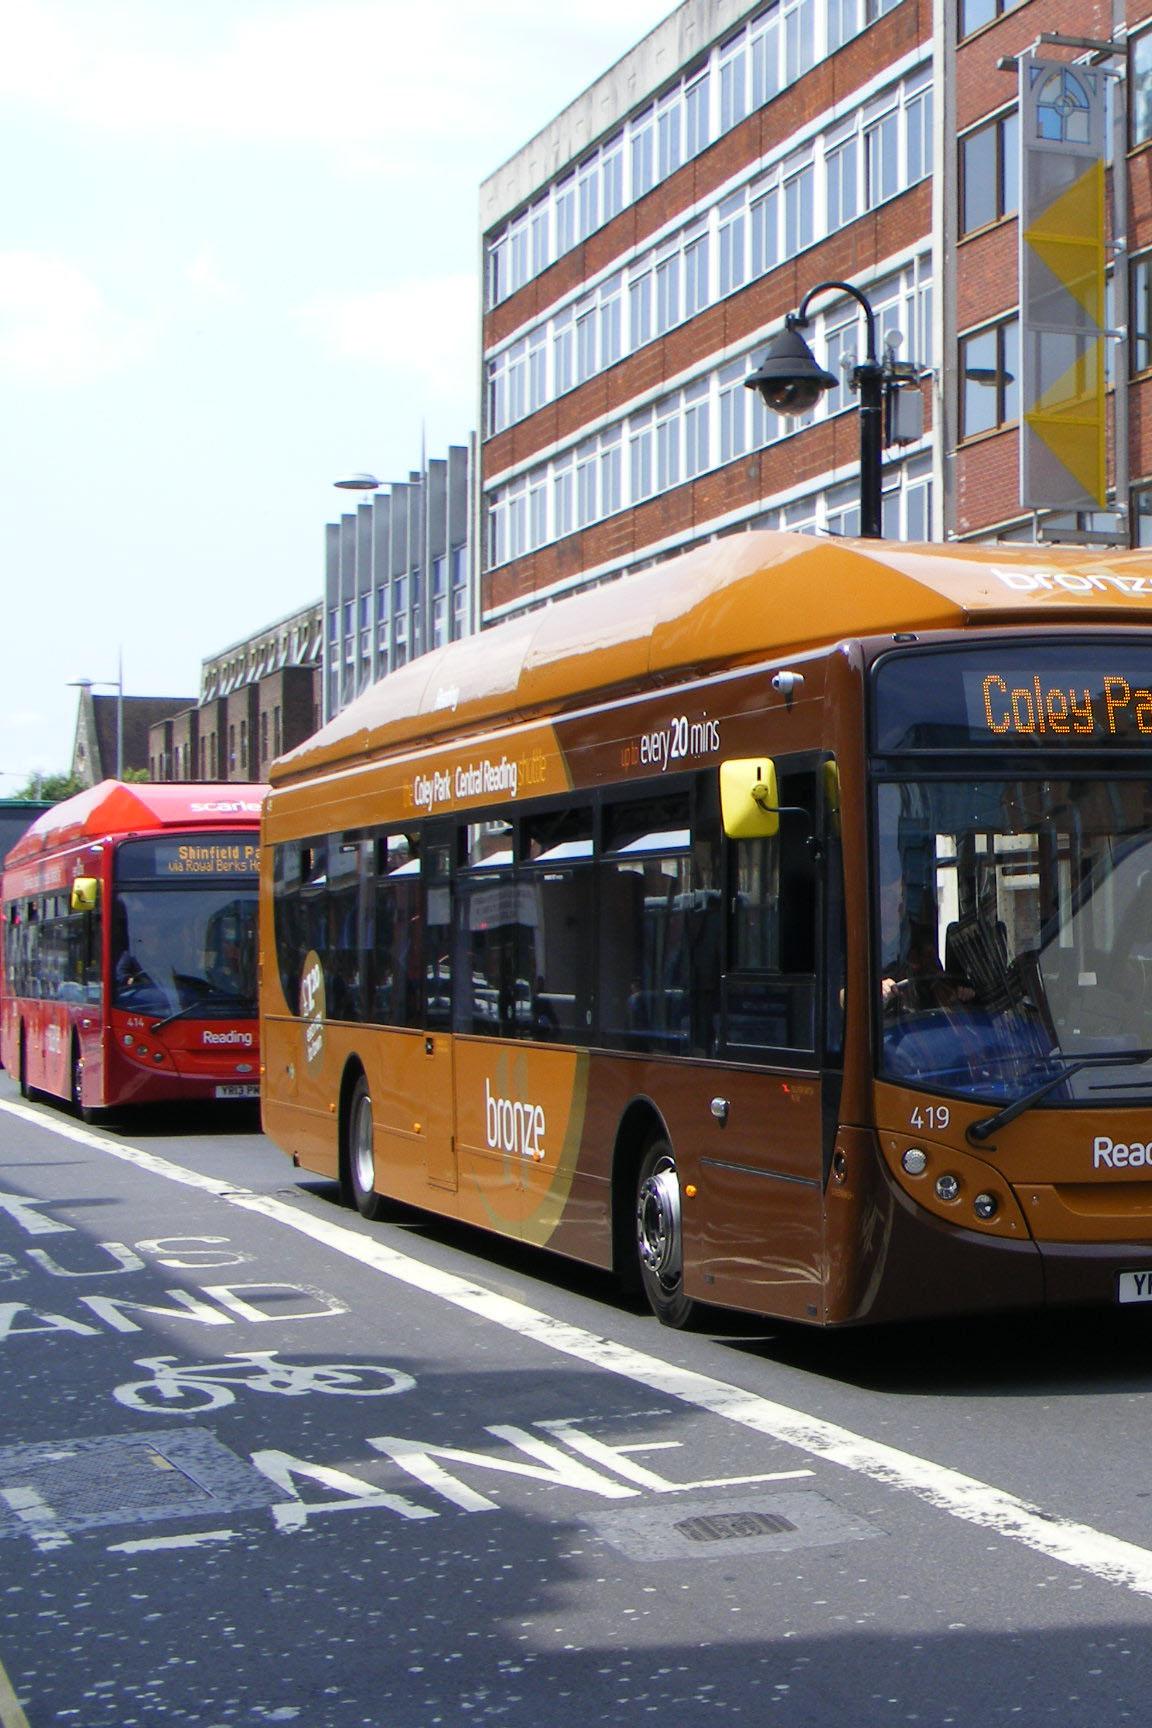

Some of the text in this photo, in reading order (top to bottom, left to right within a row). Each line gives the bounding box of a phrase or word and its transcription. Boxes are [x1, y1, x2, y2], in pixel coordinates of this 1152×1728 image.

[983, 675, 1094, 733] Coley
[641, 731, 670, 771] every
[671, 716, 688, 758] 20
[691, 711, 720, 755] mins
[414, 775, 433, 811] Coley
[434, 769, 451, 801] Park
[456, 761, 483, 797] Central
[484, 756, 517, 797] Reading
[190, 800, 262, 812] scarle
[178, 846, 239, 859] Shinfield
[216, 860, 247, 872] Berks
[126, 1018, 145, 1027] 414
[203, 1030, 253, 1046] Reading
[223, 1085, 244, 1096] YR13
[485, 1077, 546, 1159] bronze
[909, 1106, 950, 1129] 419
